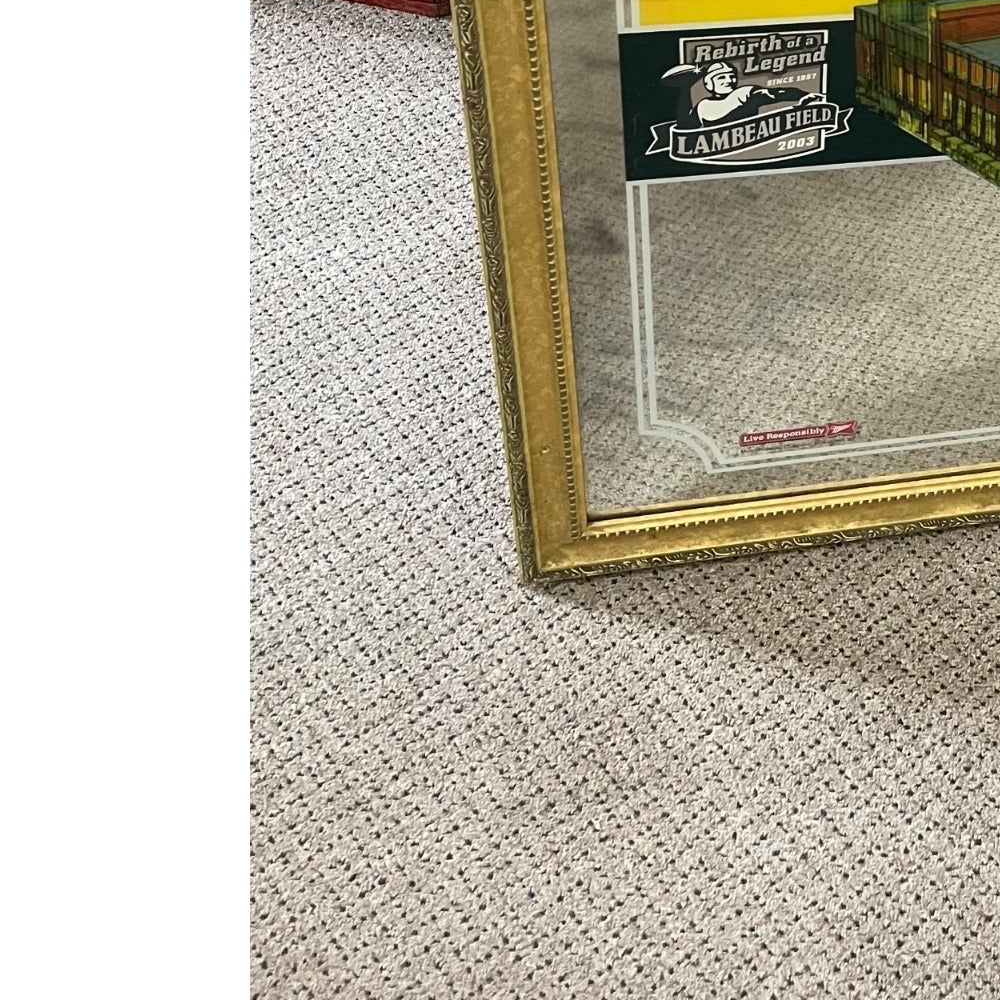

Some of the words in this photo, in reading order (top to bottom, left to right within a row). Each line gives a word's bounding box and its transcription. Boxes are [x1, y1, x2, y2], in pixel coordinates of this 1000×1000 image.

[695, 35, 782, 62] Rebirth
[786, 36, 803, 49] of
[804, 36, 815, 47] a
[743, 45, 826, 74] Legend
[766, 76, 795, 87] SINCE
[677, 121, 781, 154] LAMBEAU
[785, 107, 832, 130] FIELD
[777, 135, 817, 151] 2003
[743, 433, 764, 443] Live
[766, 427, 825, 440] Responsibly
